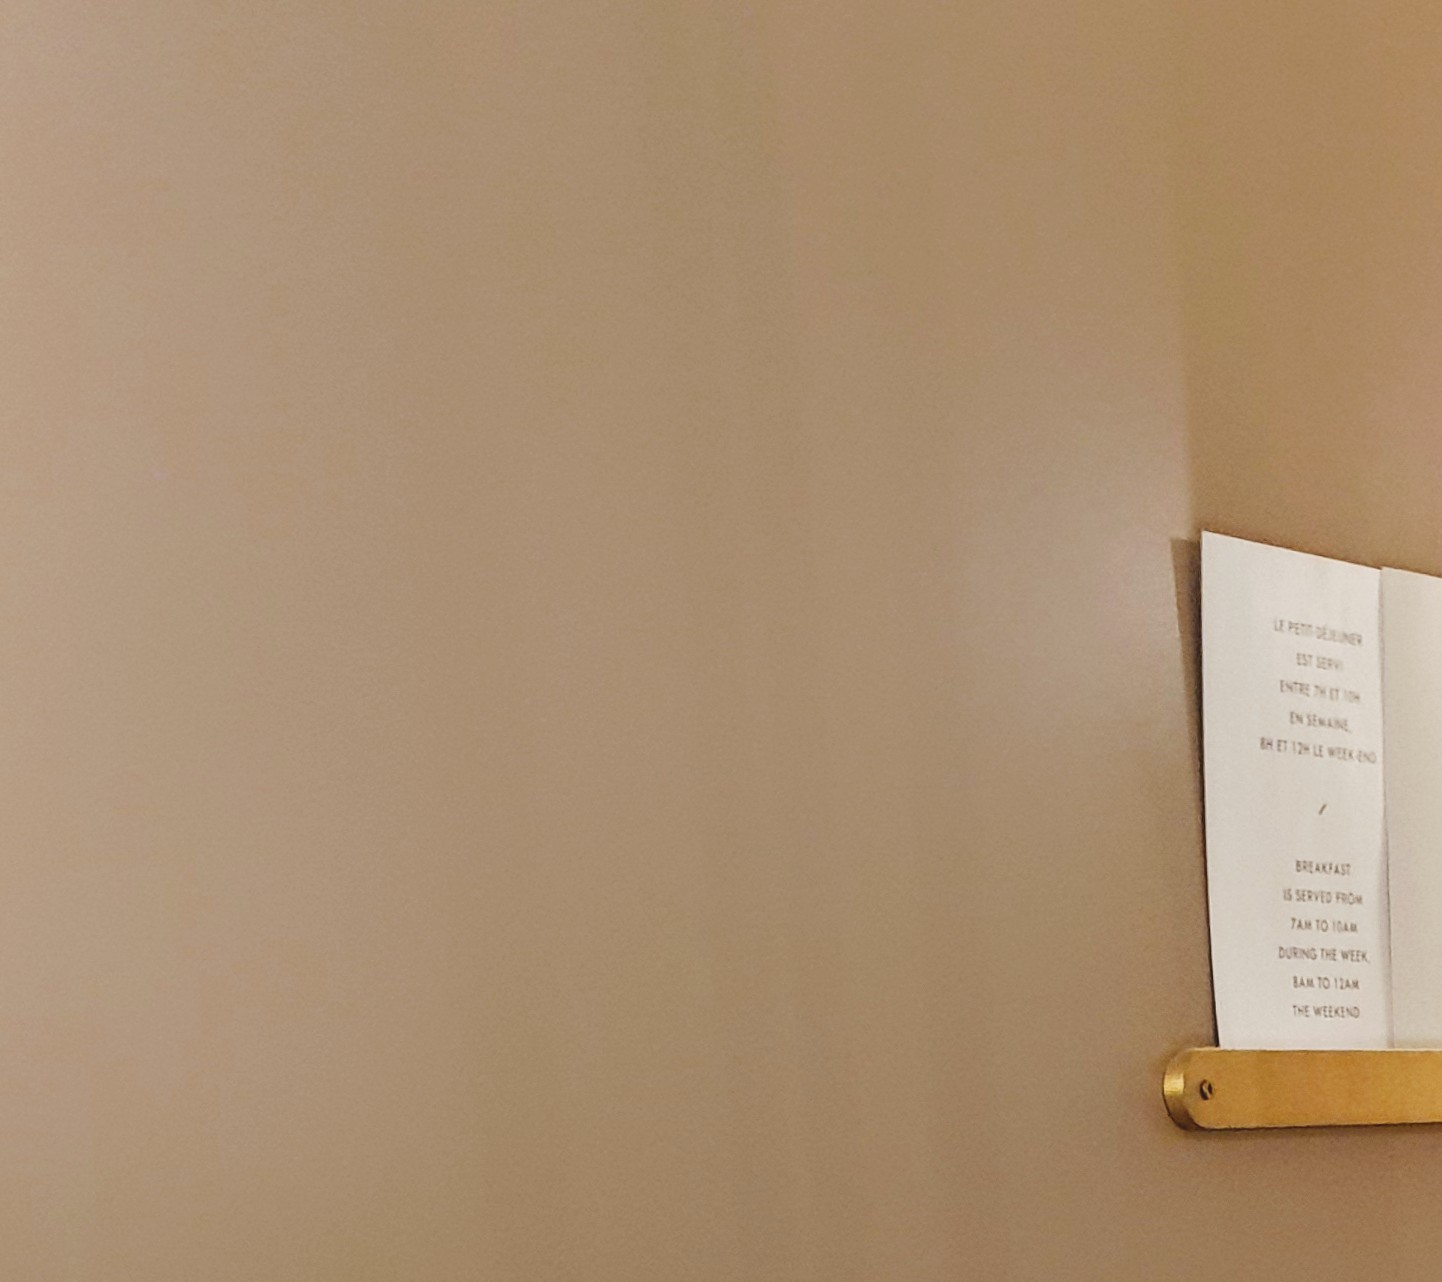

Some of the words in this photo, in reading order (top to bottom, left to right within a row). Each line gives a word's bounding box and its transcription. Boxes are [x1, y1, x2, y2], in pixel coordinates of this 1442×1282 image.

[1296, 652, 1313, 667] EST
[1280, 679, 1310, 697] ENTRE
[1330, 688, 1340, 701] ET
[1290, 711, 1303, 725] EN
[1277, 739, 1288, 752] ET
[1292, 741, 1310, 755] 12H
[1313, 745, 1324, 758] LE
[1295, 860, 1351, 876] BREAKFAST
[1283, 888, 1292, 902] IS
[1295, 889, 1332, 904] SERVED
[1335, 891, 1363, 906] FROM
[1290, 917, 1312, 931] 7AM
[1315, 919, 1328, 933] TO
[1332, 920, 1358, 934] 10AM
[1278, 946, 1317, 960] DURING
[1320, 948, 1337, 961] THE
[1293, 975, 1314, 989] 8AM
[1317, 976, 1330, 990] TO
[1334, 977, 1360, 990] 12AM
[1293, 1005, 1309, 1018] THE
[1313, 1005, 1360, 1019] WEEKEND
